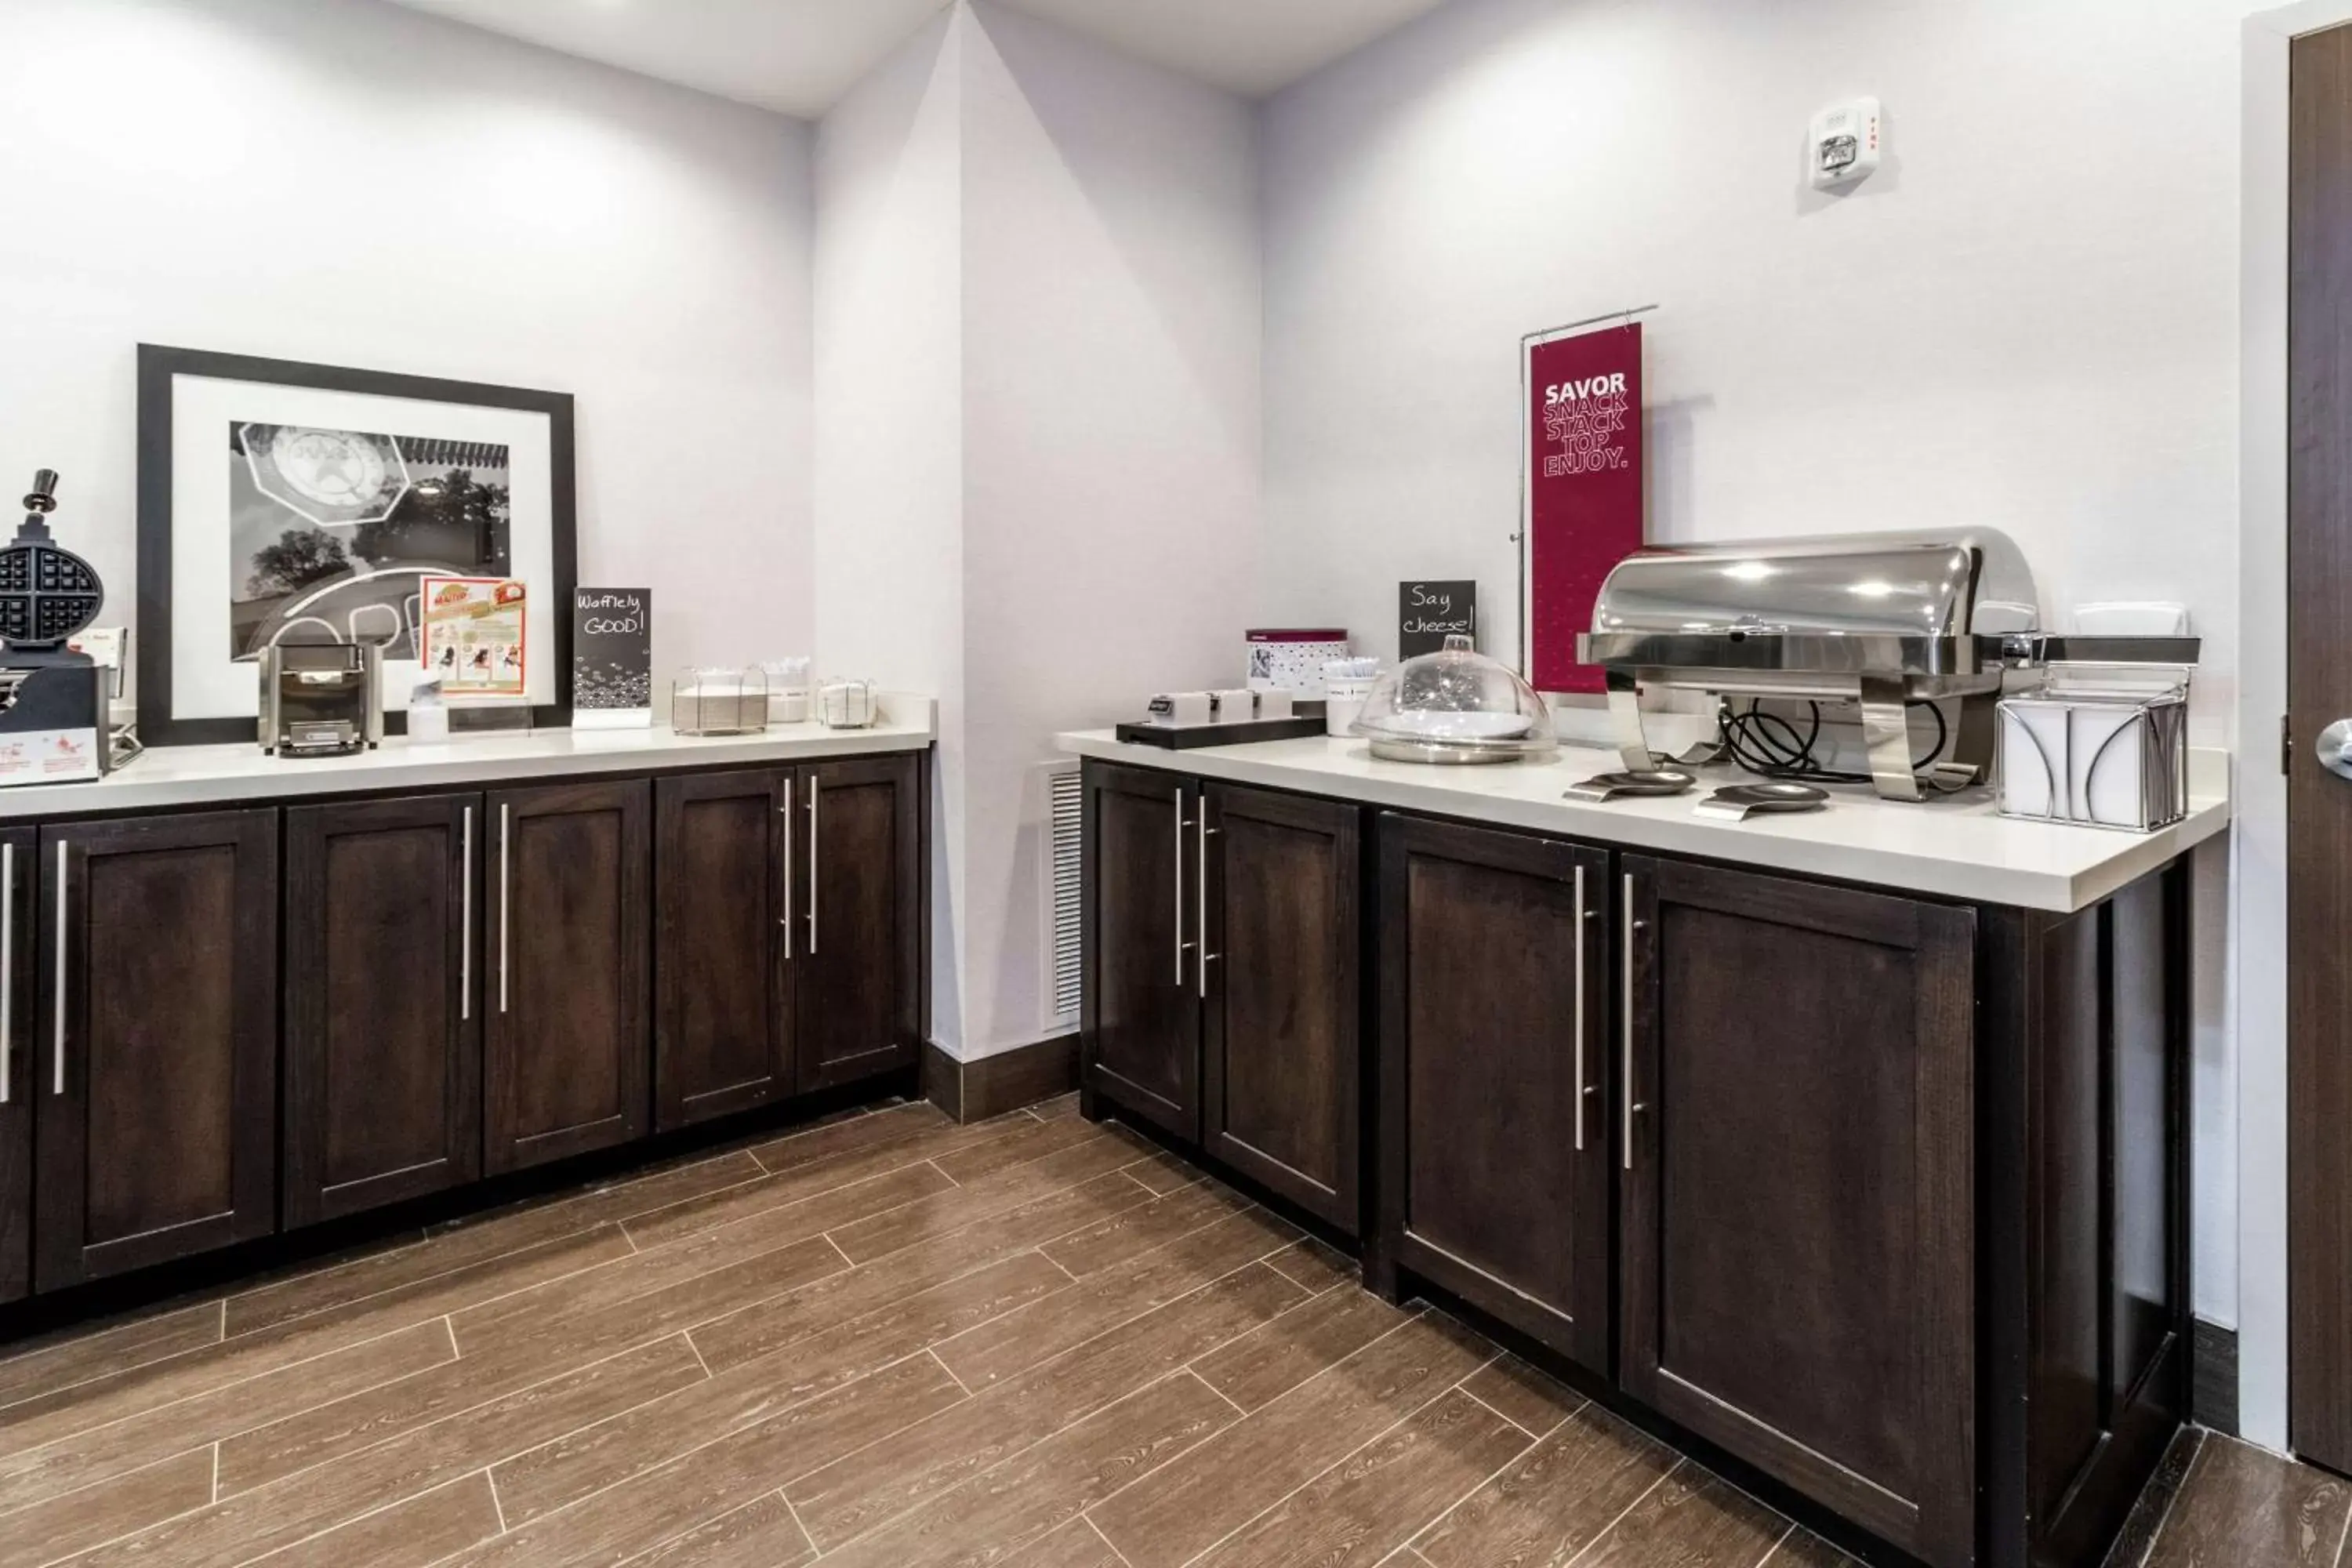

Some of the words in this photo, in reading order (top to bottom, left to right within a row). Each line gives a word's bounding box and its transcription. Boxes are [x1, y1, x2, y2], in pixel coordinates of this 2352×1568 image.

[1545, 372, 1625, 405] SAVOR
[1543, 389, 1628, 423] SNACK
[1547, 408, 1625, 441] STACK
[1561, 432, 1609, 455] TOP
[1544, 446, 1628, 477] ENJOY.
[1410, 585, 1450, 615] Say
[584, 609, 644, 637] GOOD!
